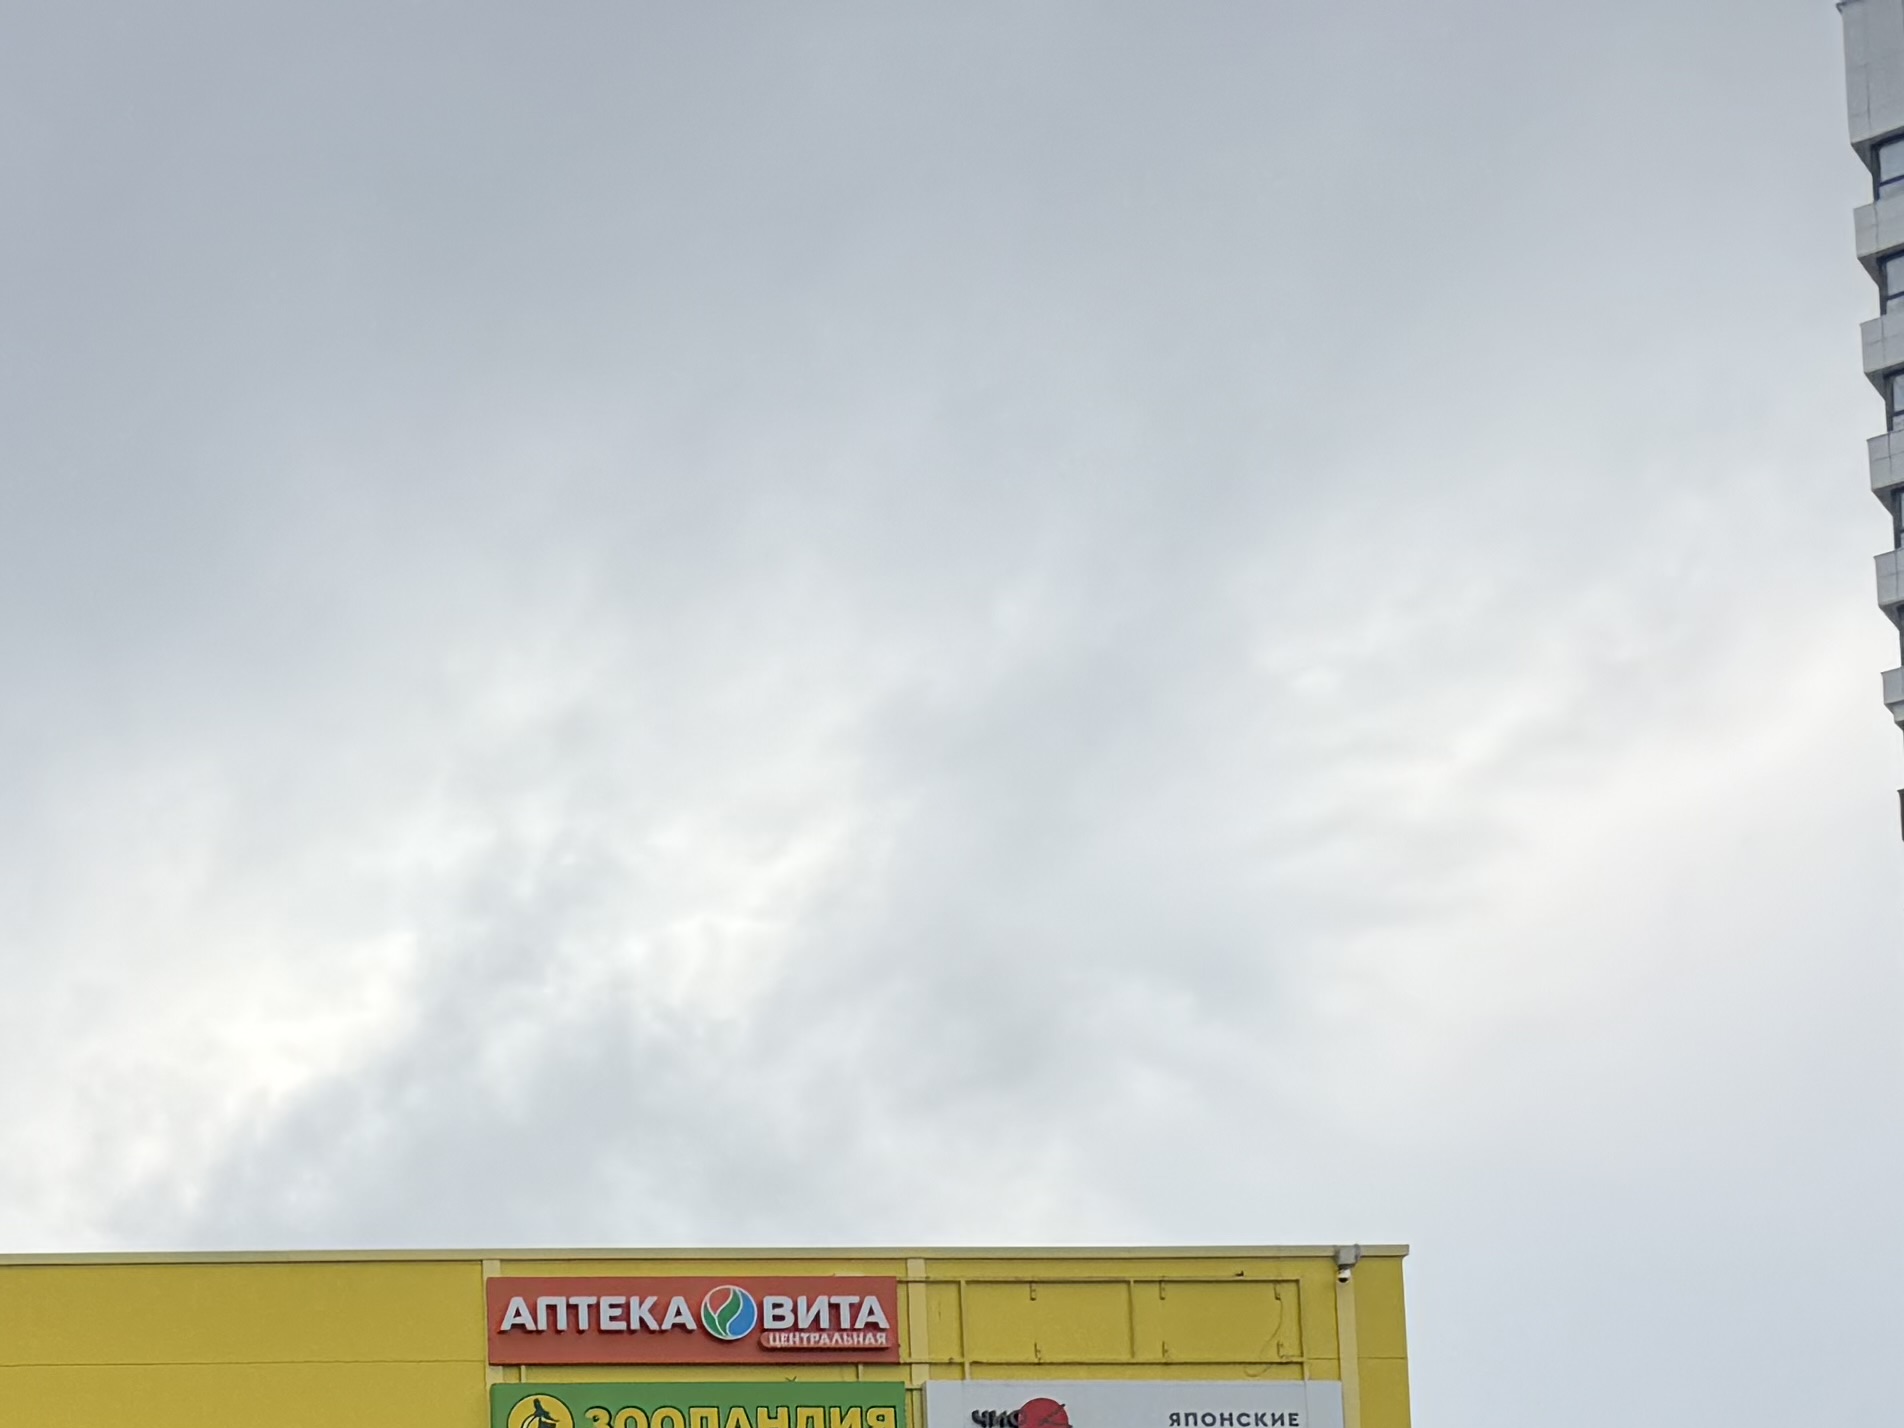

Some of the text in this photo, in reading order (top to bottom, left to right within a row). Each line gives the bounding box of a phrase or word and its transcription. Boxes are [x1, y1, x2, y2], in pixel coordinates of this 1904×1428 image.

[500, 1295, 890, 1332] АПТЕКА ВИТА
[768, 1332, 887, 1348] ЦЕНТРАЛЬНАЯ
[1169, 1412, 1300, 1428] ЯПОНСКИЕ
